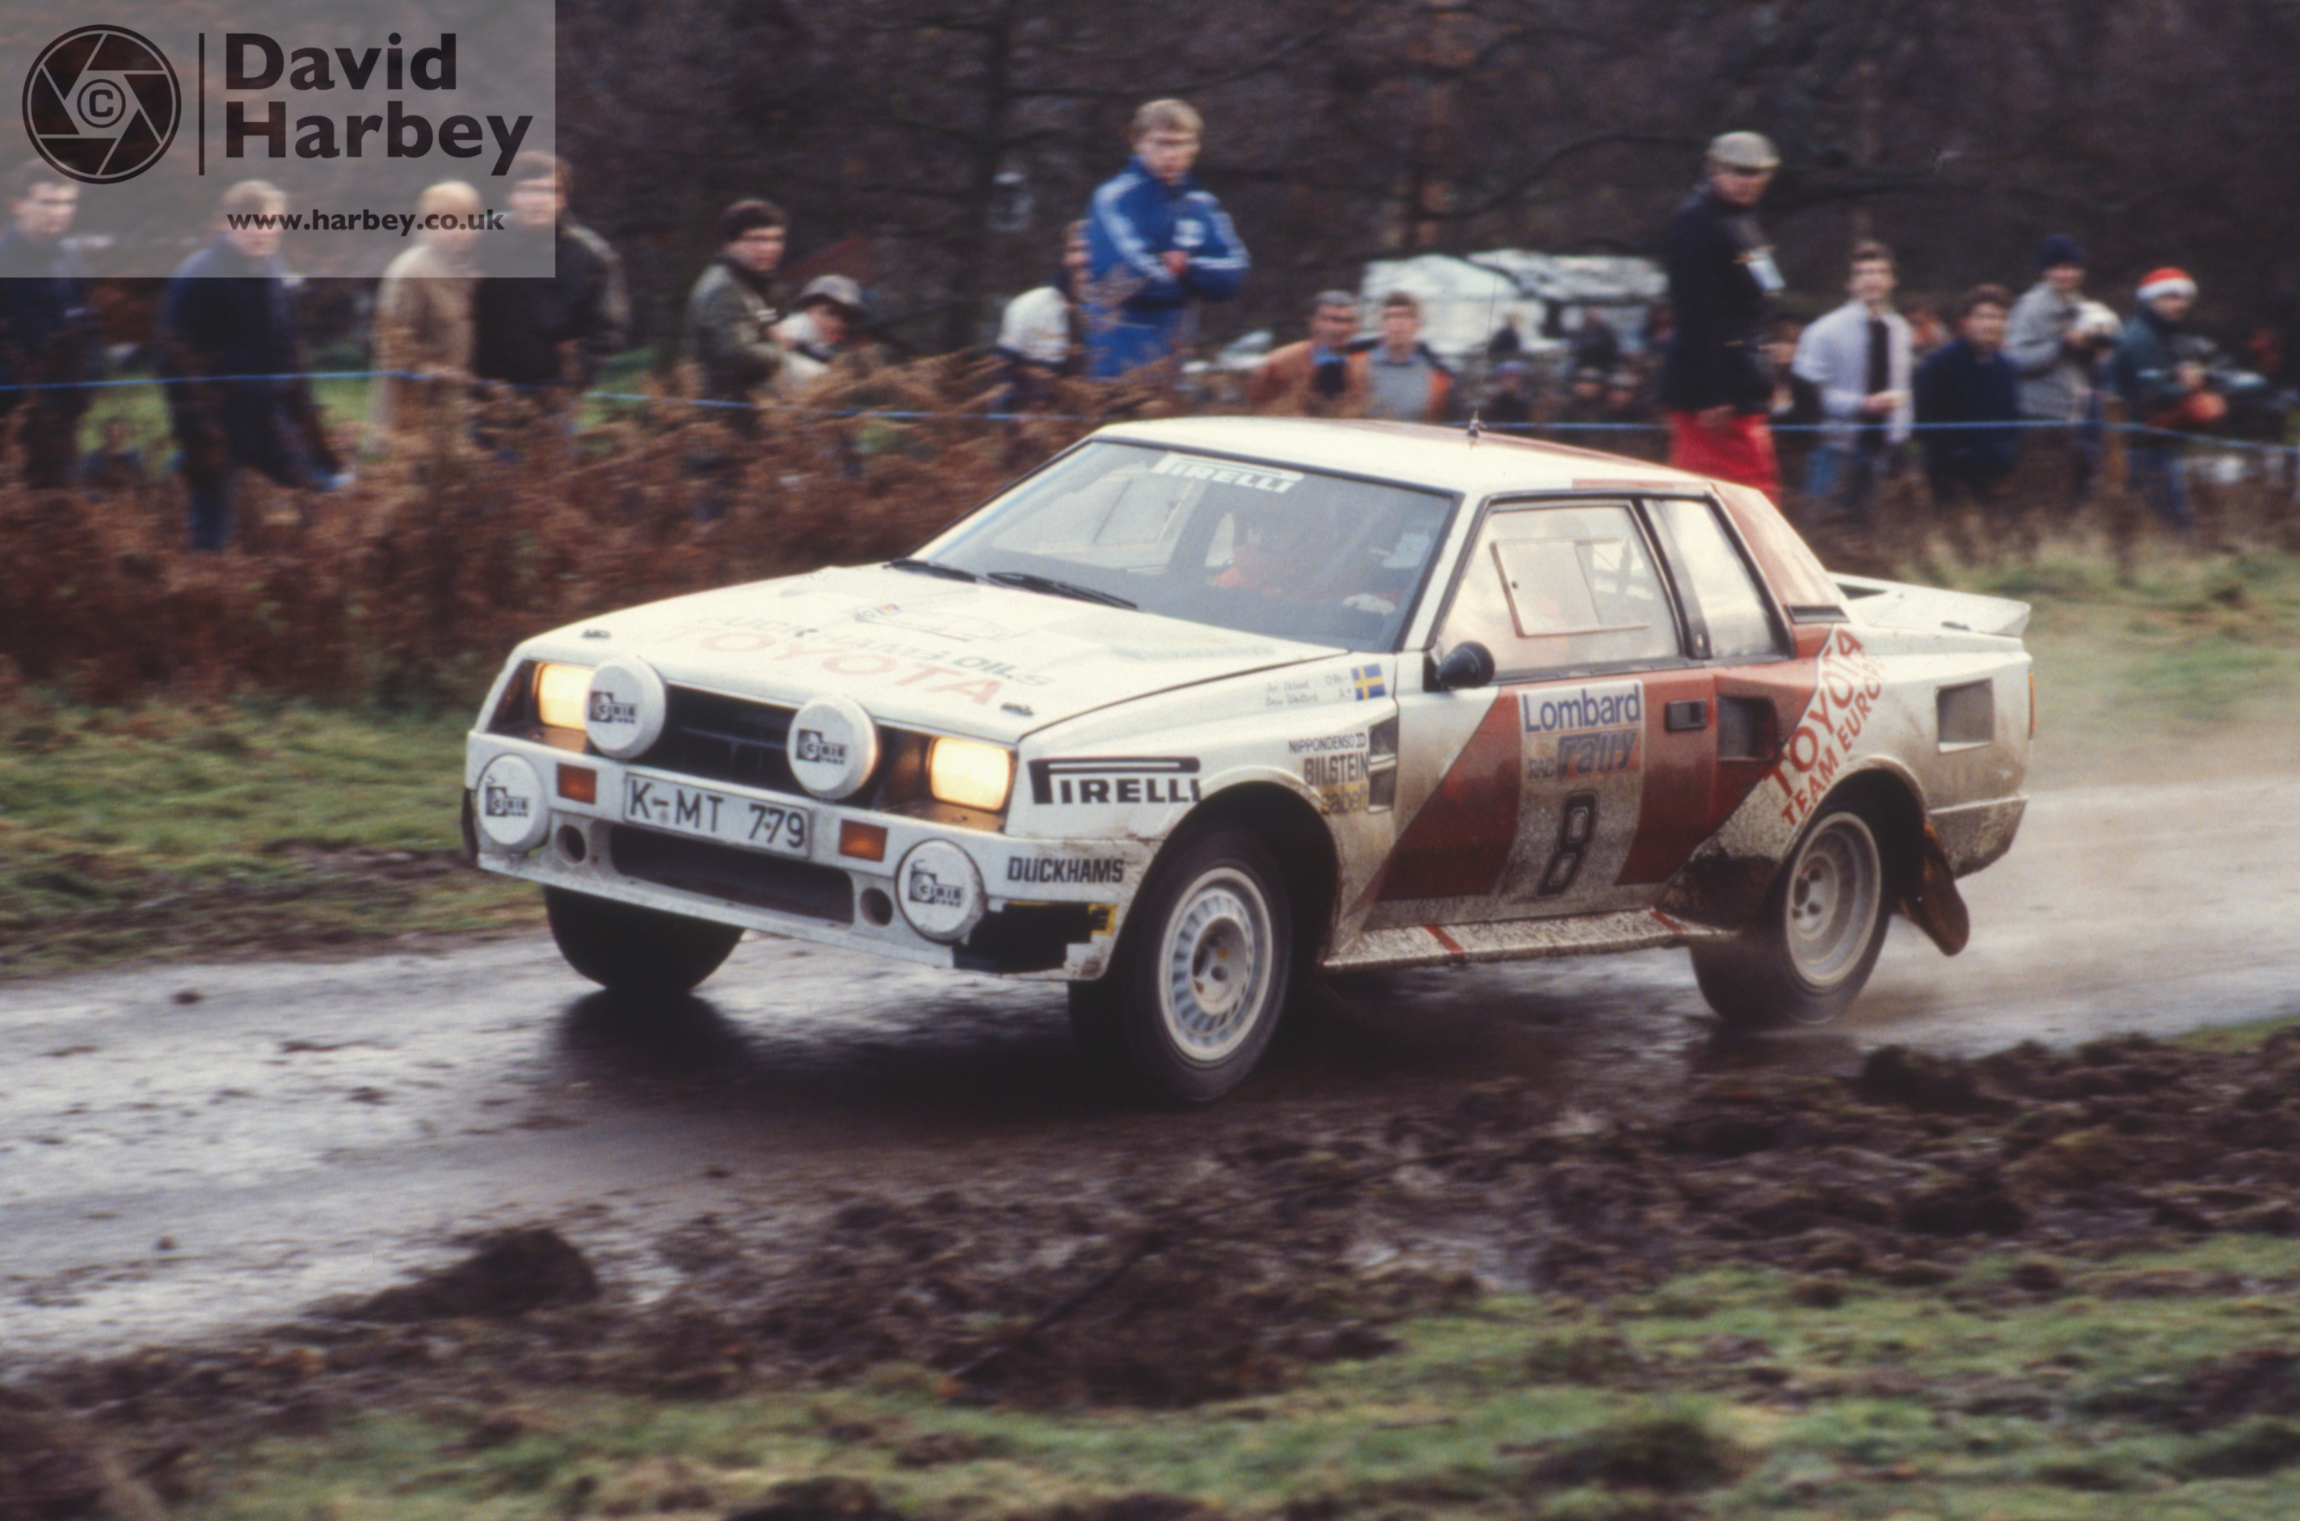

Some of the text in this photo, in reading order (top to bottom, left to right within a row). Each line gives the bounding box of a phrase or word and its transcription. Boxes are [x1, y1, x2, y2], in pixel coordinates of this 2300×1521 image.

[1151, 451, 1304, 493] PIRELLI
[655, 624, 1003, 706] TOYOTA
[1522, 683, 1641, 733] Lombard
[1763, 627, 1863, 798] TOYOTA
[1288, 734, 1355, 753] NIPPONDENSO
[1528, 731, 1638, 779] RAC rally
[1028, 757, 1200, 804] PIRELLI
[1304, 752, 1370, 787] BILSTEIN
[1781, 746, 1839, 827] TEAM
[630, 780, 806, 848] K-MT 779
[1537, 790, 1598, 897] 8
[1007, 856, 1124, 883] DUCKHAMS
